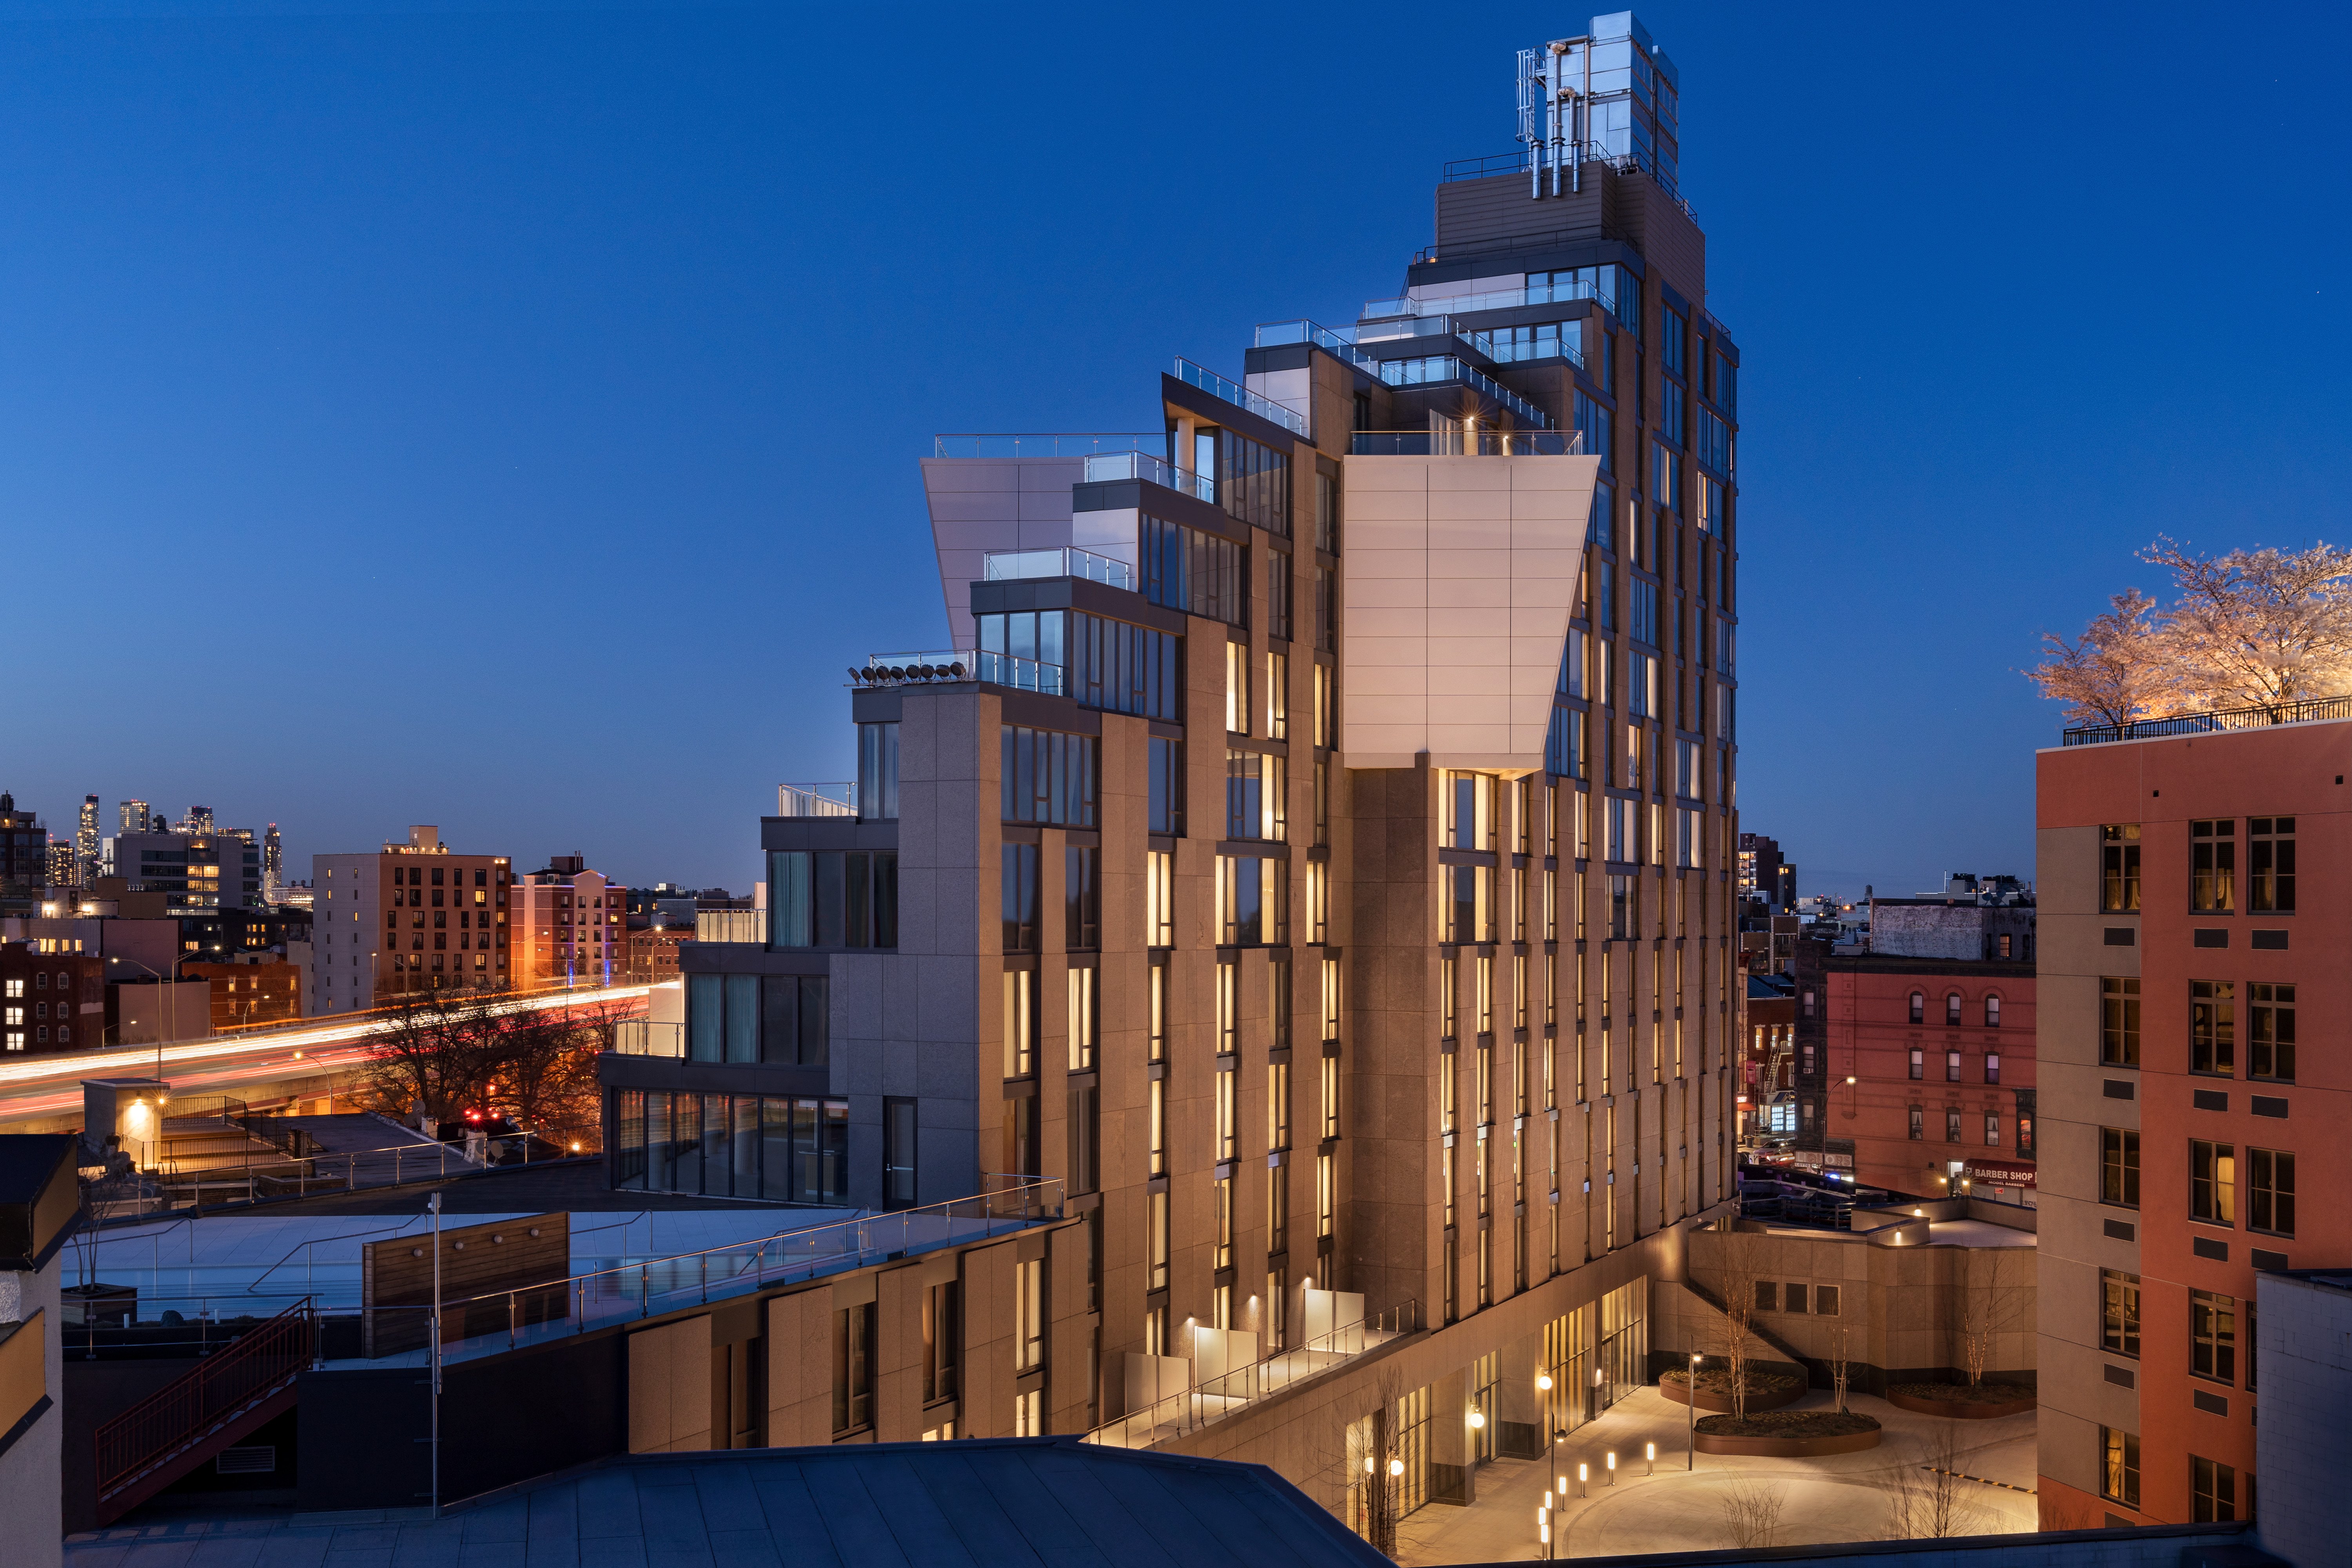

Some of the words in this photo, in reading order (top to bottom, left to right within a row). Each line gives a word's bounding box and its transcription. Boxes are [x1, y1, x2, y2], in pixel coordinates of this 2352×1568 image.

[1797, 1152, 1850, 1166] LIQUORS
[1975, 1169, 2008, 1179] BARBER
[2010, 1172, 2033, 1181] SHOP
